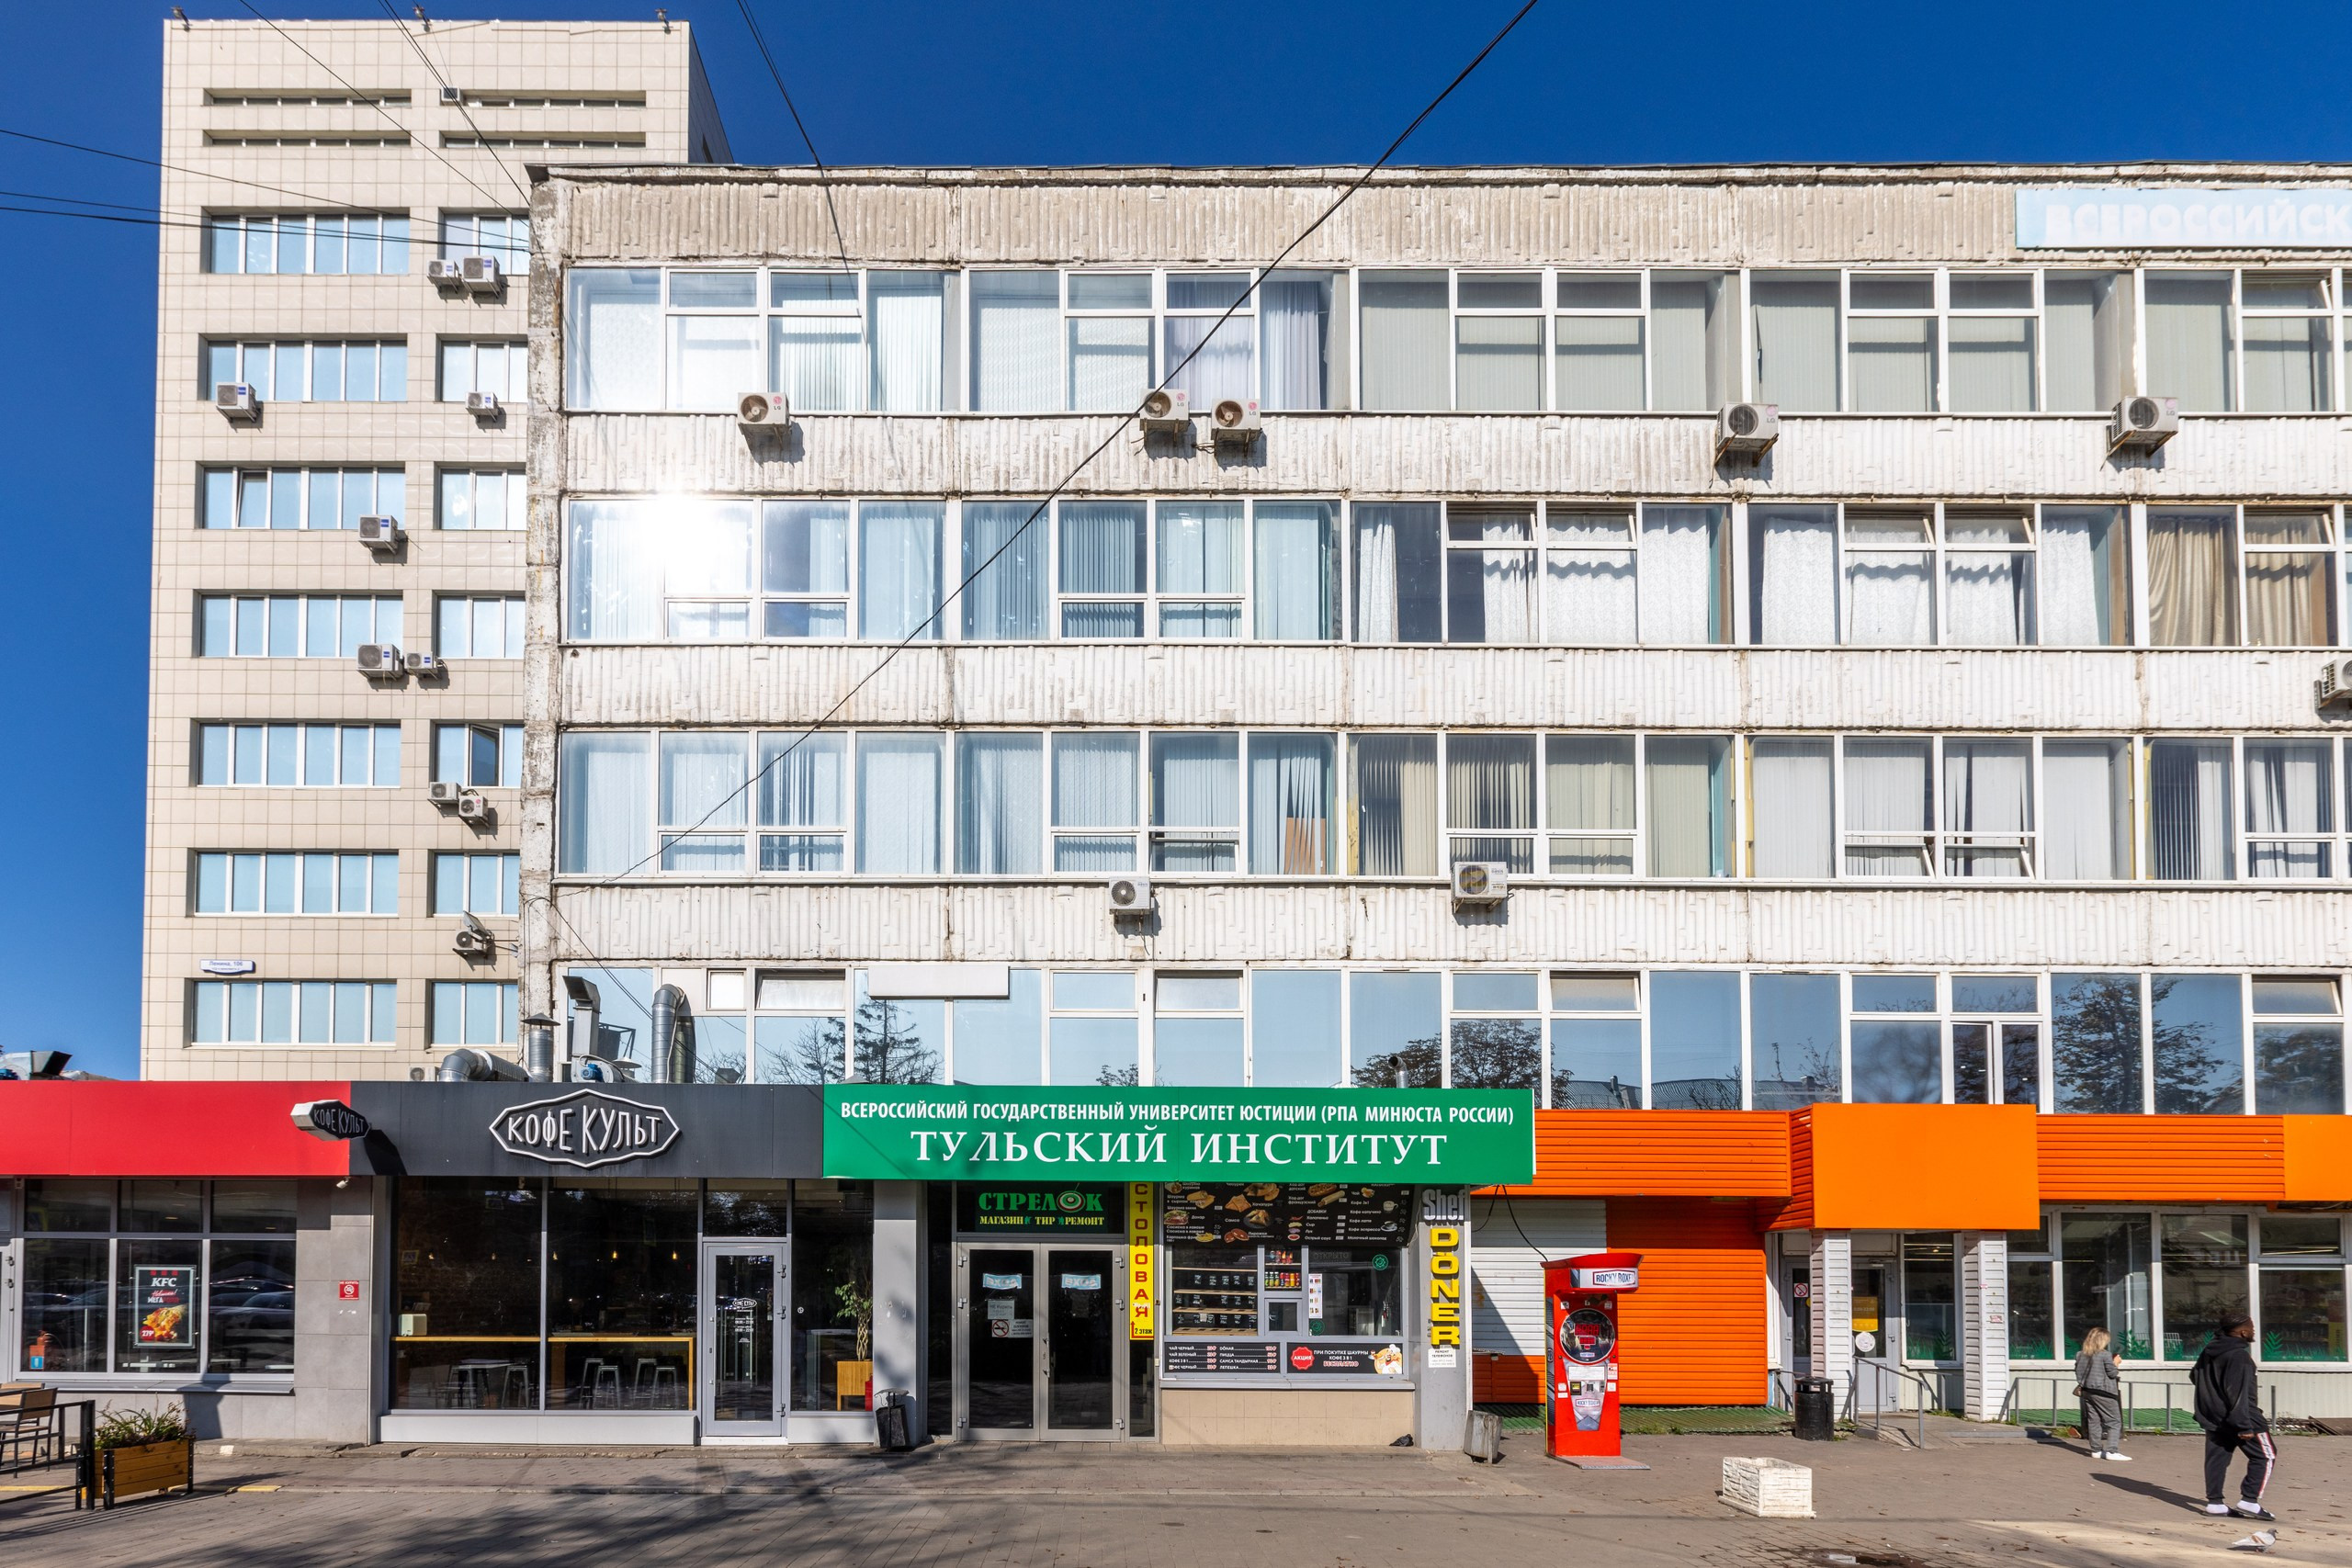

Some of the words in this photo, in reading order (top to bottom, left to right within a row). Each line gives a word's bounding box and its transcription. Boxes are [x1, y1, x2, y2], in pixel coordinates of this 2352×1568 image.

[314, 1109, 336, 1132] КОФЕ
[338, 1108, 364, 1134] КУЛЬТ
[841, 1100, 967, 1120] ВСЕРОССИЙСКИЙ
[973, 1101, 1124, 1122] ГОСУДАРСТВЕННЫЙ
[1129, 1103, 1234, 1122] УНИВЕРСИТЕТ
[1239, 1106, 1317, 1123] ЮСТИЦИИ
[1321, 1105, 1358, 1124] (РПА
[1365, 1106, 1442, 1123] МИНЮСТА
[1449, 1107, 1514, 1125] РОССИИ)
[508, 1109, 573, 1151] КОФЕ
[582, 1105, 661, 1154] КУЛЬТ
[910, 1123, 1168, 1164] ТУЛЬСКИЙ
[1190, 1133, 1448, 1165] ИНСТИТУТ
[978, 1190, 1102, 1213] СТРЕЛОК
[1422, 1188, 1465, 1221] Shef
[979, 1216, 1023, 1224] МАГАЗИН
[1035, 1216, 1056, 1225] ТИР
[1065, 1217, 1104, 1225] РЕМОНТ
[1134, 1183, 1149, 1318] СТОЛОВАЯ
[152, 1278, 176, 1287] KFC
